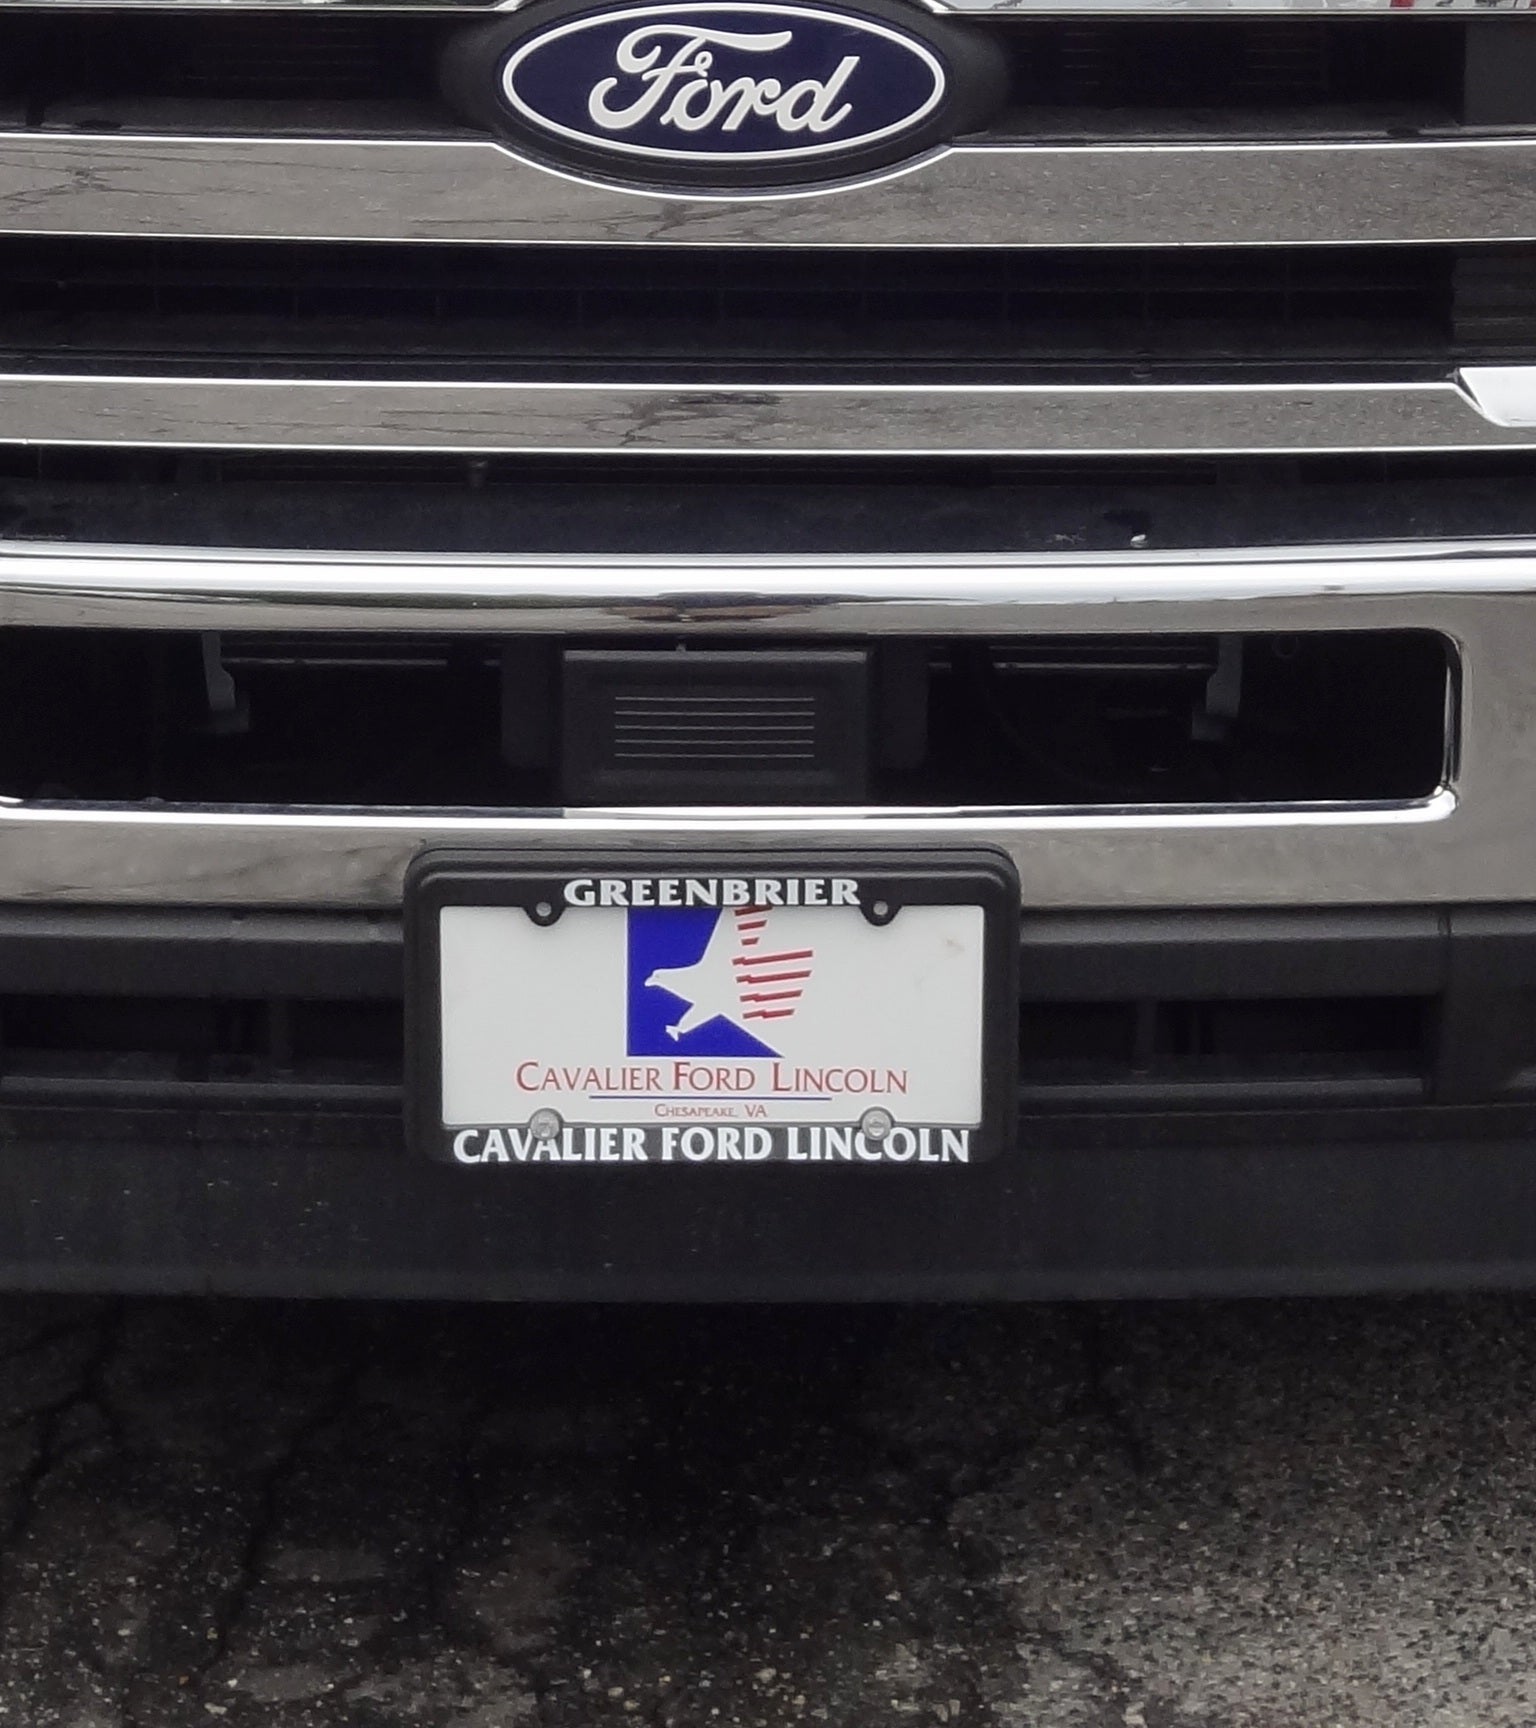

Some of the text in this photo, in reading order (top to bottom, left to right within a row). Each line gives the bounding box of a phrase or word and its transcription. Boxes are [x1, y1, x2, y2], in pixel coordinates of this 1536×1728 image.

[587, 23, 861, 132] Ford
[563, 878, 862, 907] GREENBRIER
[515, 1060, 908, 1095] CAVALIER FORD LINCOLN
[744, 1103, 769, 1118] VA
[452, 1126, 970, 1164] CAVALIER FORD LINCOLN
